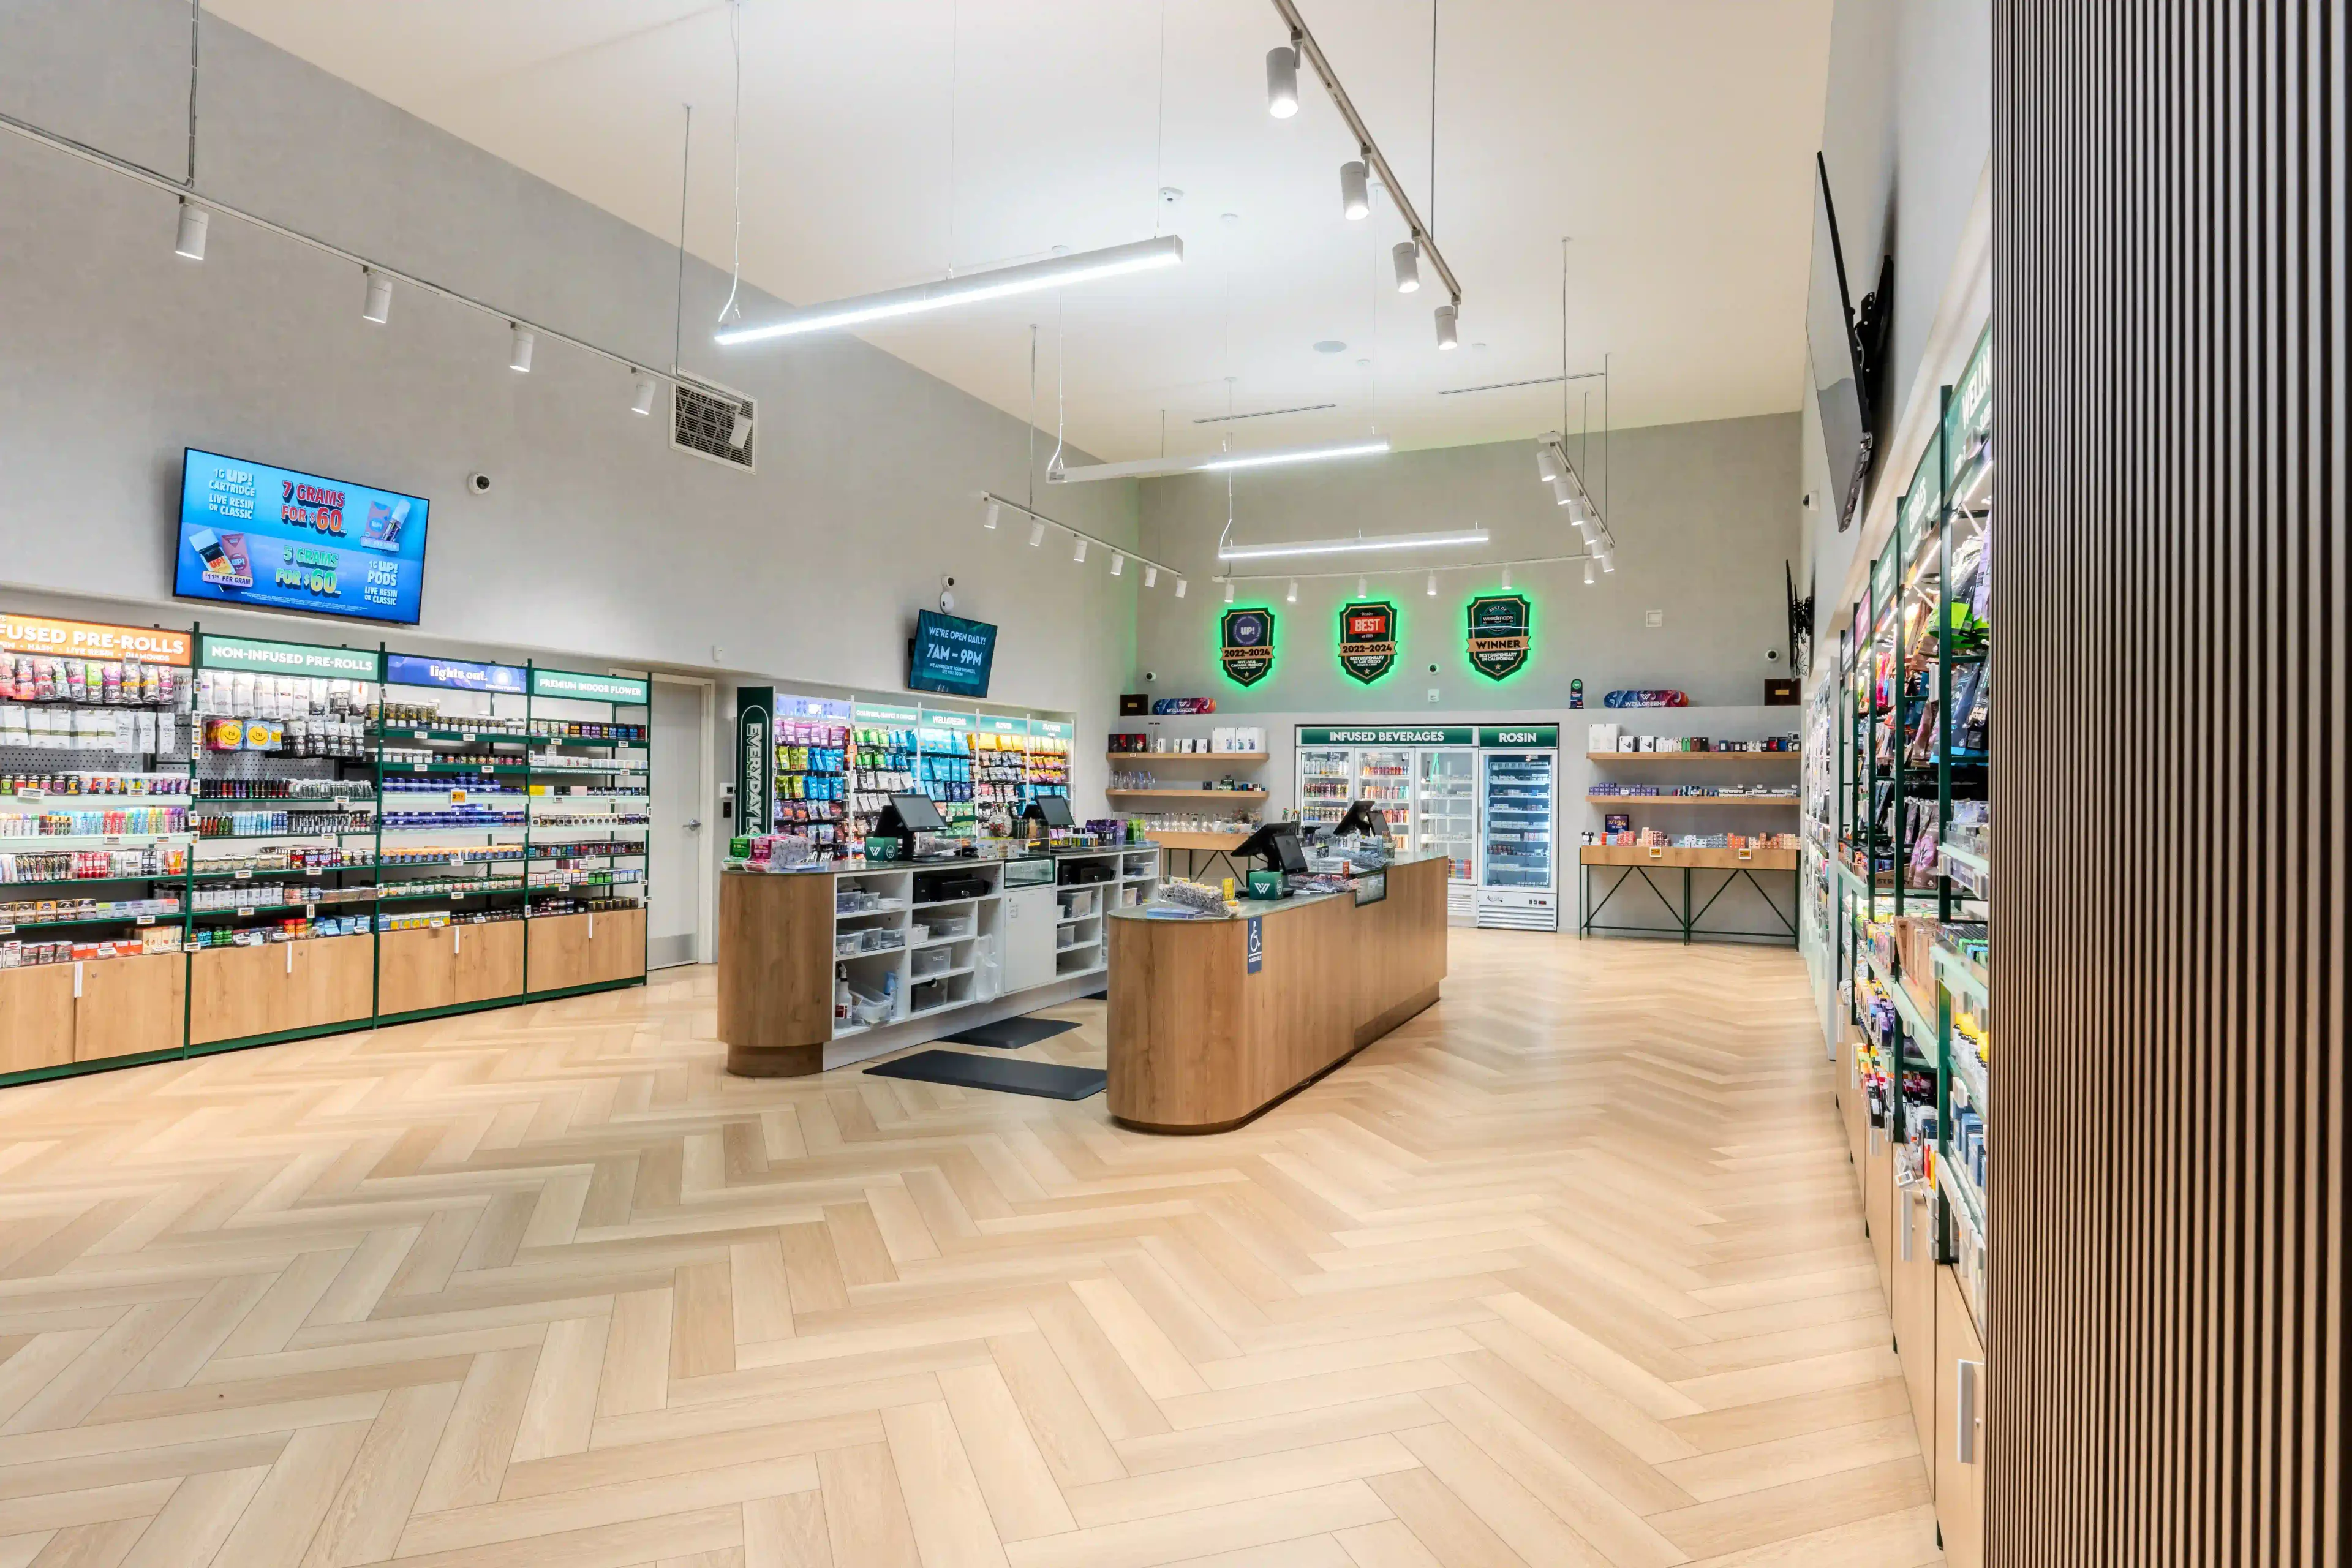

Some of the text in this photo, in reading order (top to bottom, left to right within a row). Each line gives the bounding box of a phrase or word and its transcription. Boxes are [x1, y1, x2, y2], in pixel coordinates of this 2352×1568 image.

[214, 469, 254, 486] 1G UP!
[209, 480, 255, 497] CARTRIDGE
[282, 480, 345, 508] 7 GRAMS
[209, 494, 254, 510] LIVE RESIN
[220, 505, 253, 519] CLASSIC
[281, 504, 343, 533] FOR $60
[284, 545, 339, 568] 5 GRAMS
[369, 560, 398, 574] 1G UP!
[276, 568, 337, 594] FOR $60
[368, 570, 397, 587] PODS
[364, 586, 397, 597] LIVE RESIN
[372, 596, 397, 606] CLASSIC
[1240, 626, 1255, 635] UP!
[1355, 618, 1381, 632] BEST
[73, 630, 184, 654] PRE-ROLLS
[929, 626, 987, 646] WE'RE OPEN DAILY!
[1224, 648, 1270, 657] 2022-2024
[1343, 644, 1392, 654] 2022-2024
[1476, 639, 1520, 650] WINNER
[212, 646, 372, 671] NON-INFUSED PRE-ROLLS
[926, 643, 951, 660] 7AM
[960, 649, 982, 666] 9PM
[430, 665, 489, 681] lights out.
[540, 678, 641, 696] PREMIUM INDOOR FLOWER
[1330, 731, 1444, 742] INFUSED BEVERAGES
[1499, 733, 1537, 743] ROSIN
[747, 723, 763, 817] EVERYDAY
